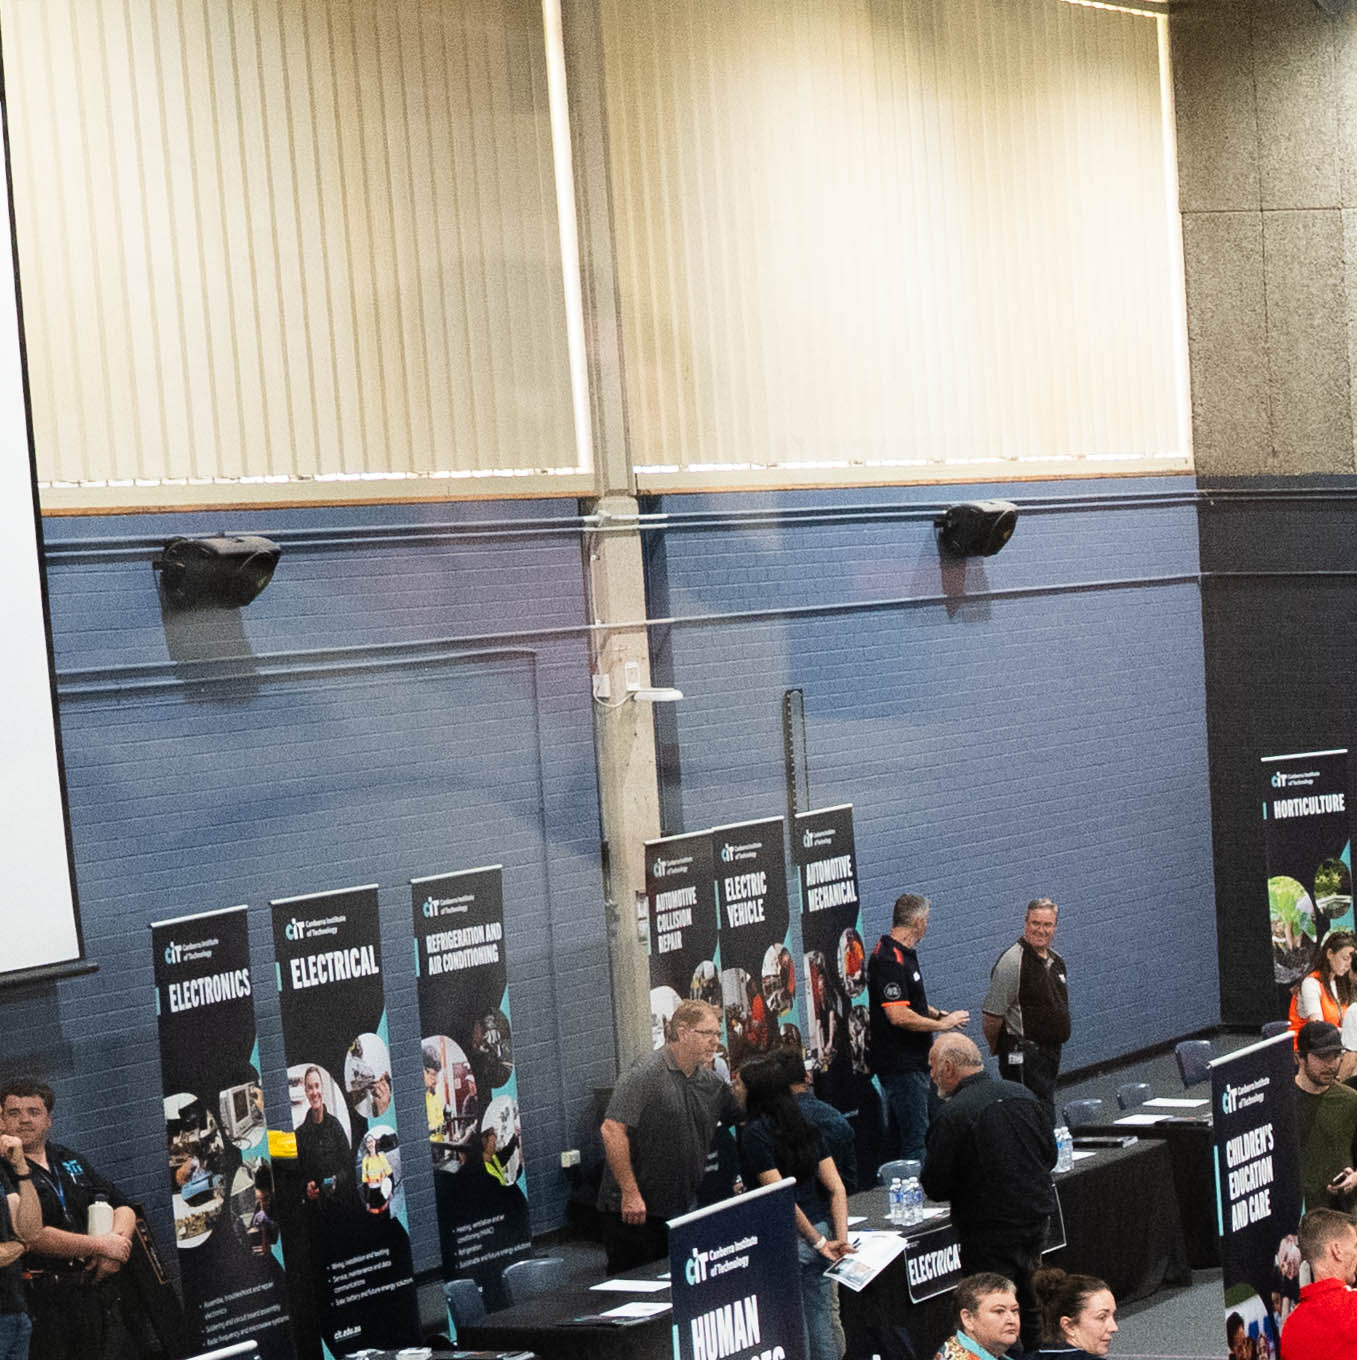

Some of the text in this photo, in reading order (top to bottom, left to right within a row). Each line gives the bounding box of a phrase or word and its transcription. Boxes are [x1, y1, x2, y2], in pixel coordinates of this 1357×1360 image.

[1273, 793, 1345, 819] HORTICULTURE
[806, 855, 853, 886] AUTOMOTIVE
[656, 886, 697, 913] AUTOMOTIVE
[725, 871, 767, 902] ELECTRIC
[807, 880, 858, 913] MECHANICAL
[657, 908, 692, 933] COLLISION
[726, 898, 765, 928] VEHICLE
[426, 922, 502, 954] REFRIGERATION AND
[658, 930, 683, 954] REPAIR
[290, 945, 379, 990] ELECTRICAL
[429, 944, 499, 976] AIR CONDITIONING
[169, 968, 251, 1013] ELECTRONICS
[1226, 1123, 1274, 1169] CHILDREN'S
[1228, 1155, 1274, 1201] EDUCATION
[1231, 1188, 1272, 1232] AND CARE
[709, 1236, 758, 1261] Canberra Institute
[710, 1255, 749, 1277] of Technology
[908, 1243, 961, 1286] ELECTRICA
